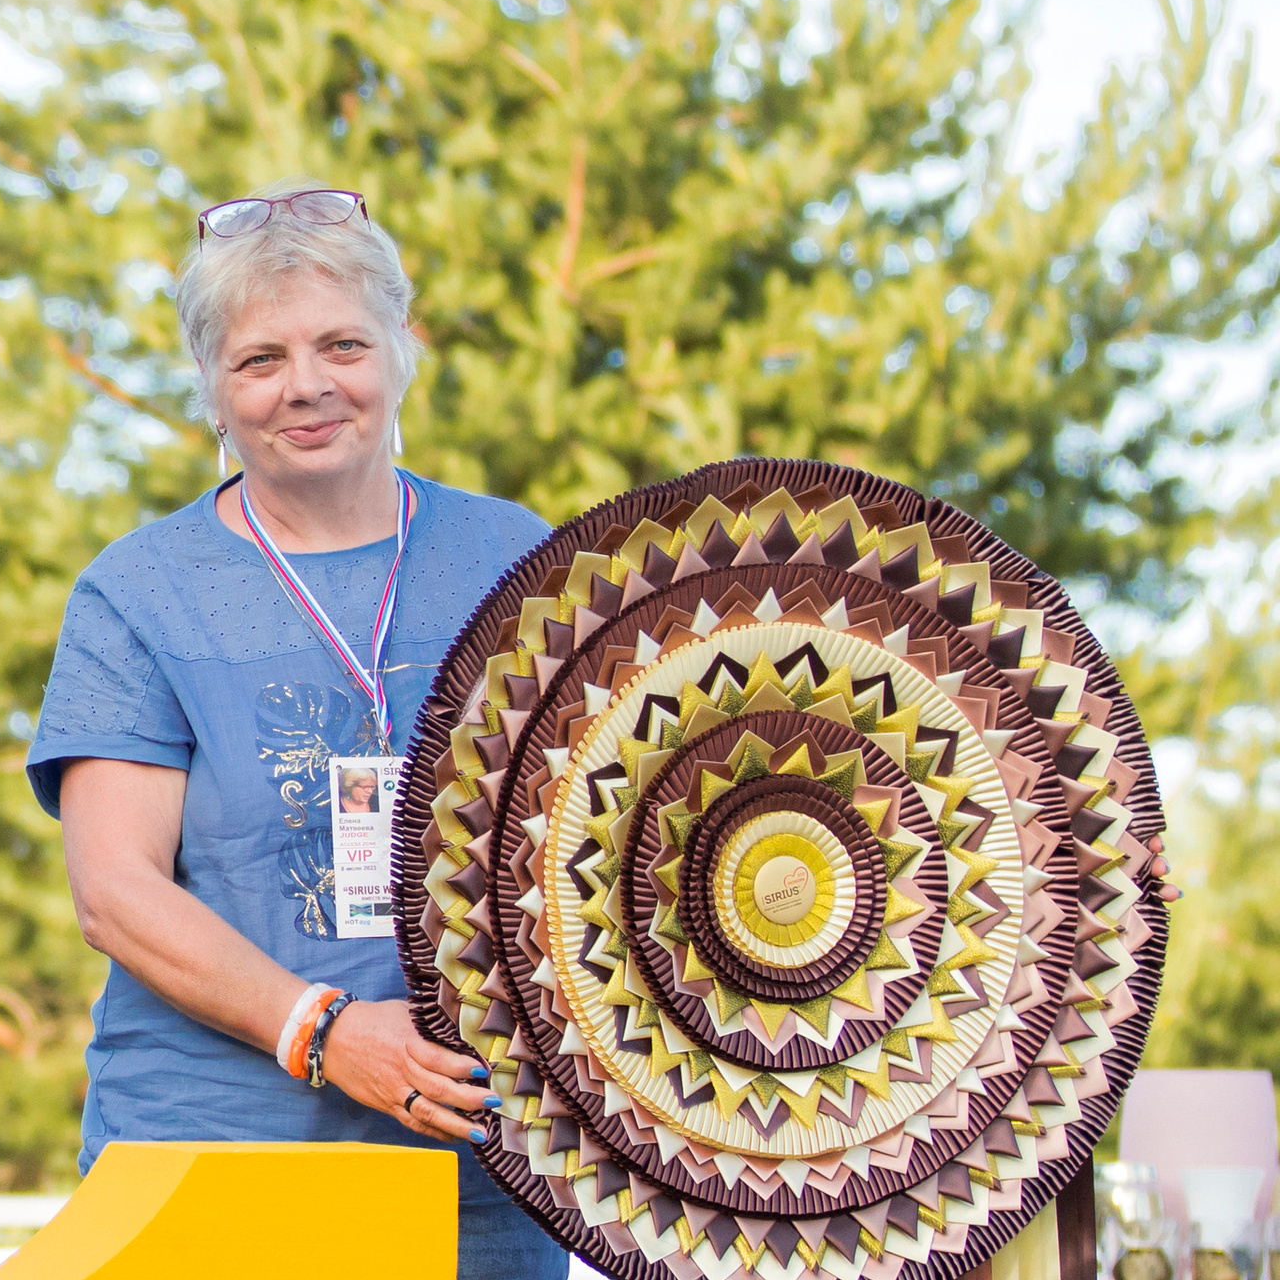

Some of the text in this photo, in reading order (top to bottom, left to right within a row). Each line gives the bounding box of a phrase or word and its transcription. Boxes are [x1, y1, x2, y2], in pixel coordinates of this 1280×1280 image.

[340, 831, 369, 839] JUDGE
[346, 849, 373, 862] VIP
[764, 886, 800, 905] SIRIUS
